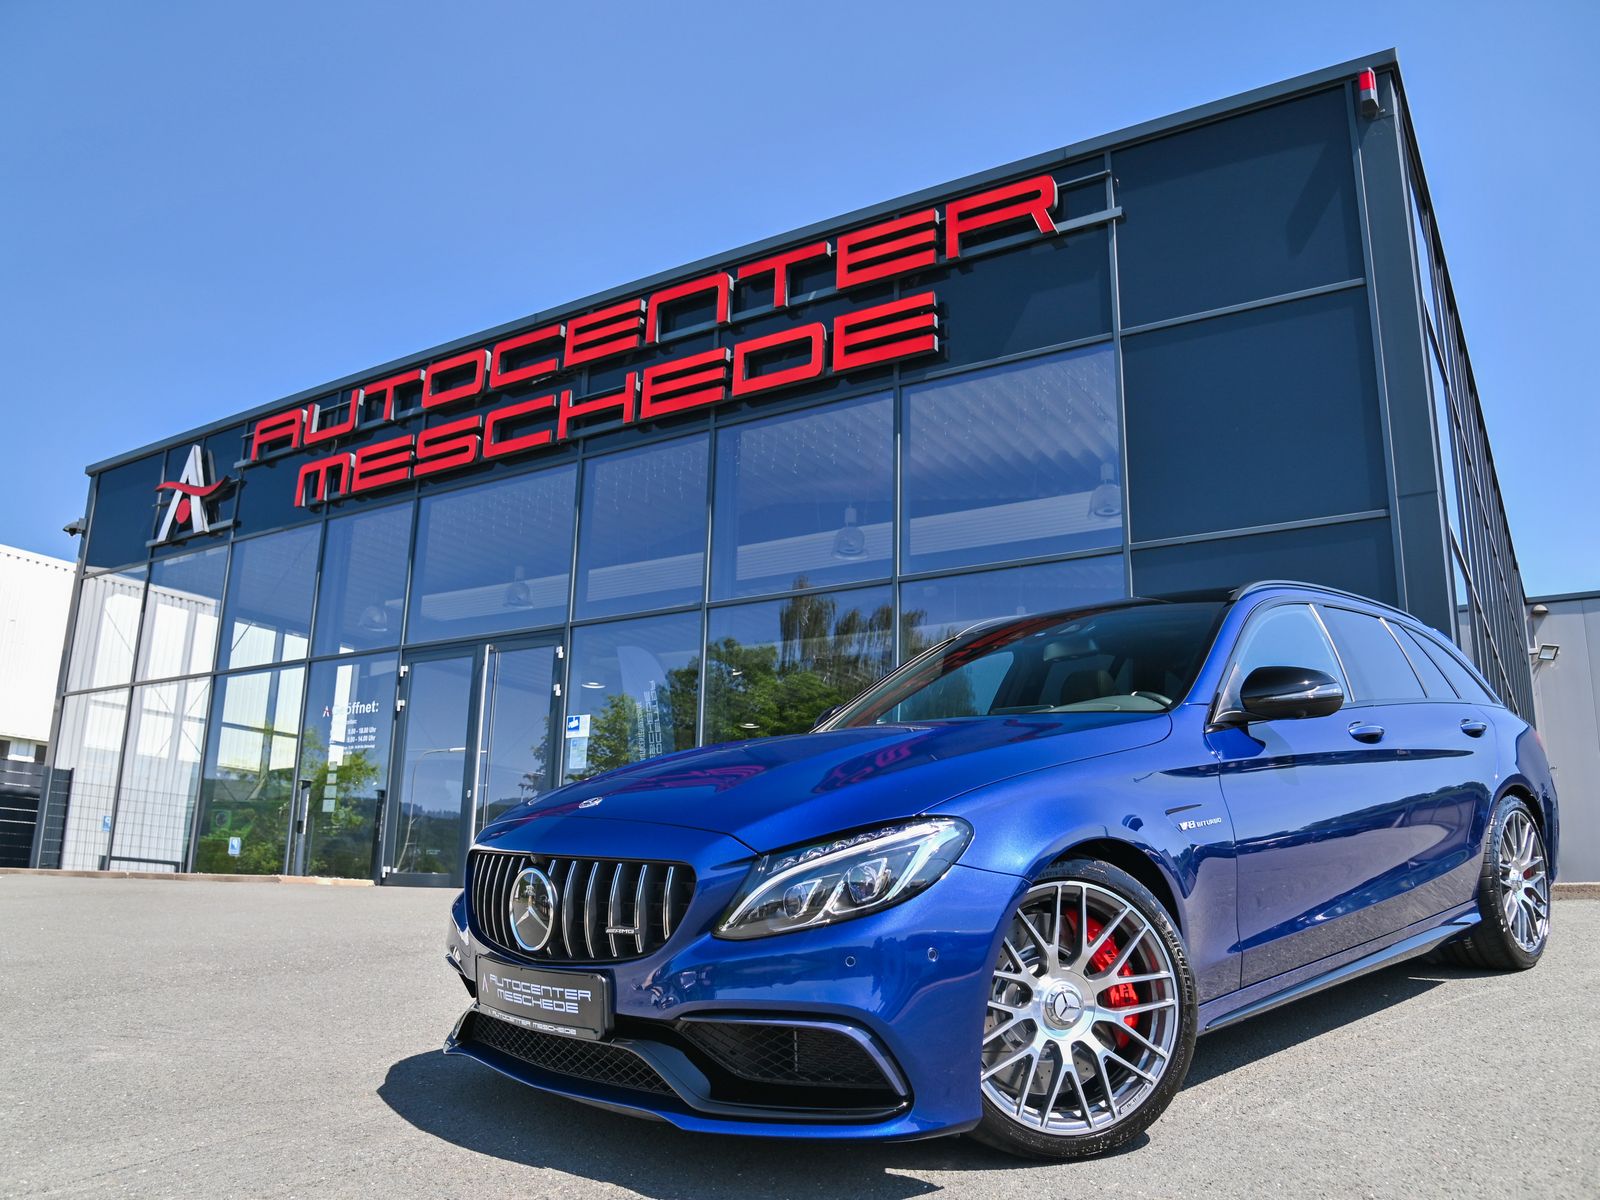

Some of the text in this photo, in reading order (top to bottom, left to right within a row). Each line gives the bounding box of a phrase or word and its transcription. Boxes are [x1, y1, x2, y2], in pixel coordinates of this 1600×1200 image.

[251, 175, 1059, 461] AUTOCENTER
[294, 291, 939, 507] MESCHEDE
[1179, 820, 1196, 831] V8
[489, 973, 592, 1002] AUTOCENTER
[1166, 929, 1193, 1001] MICHELIN
[497, 988, 579, 1014] MESCHEDE
